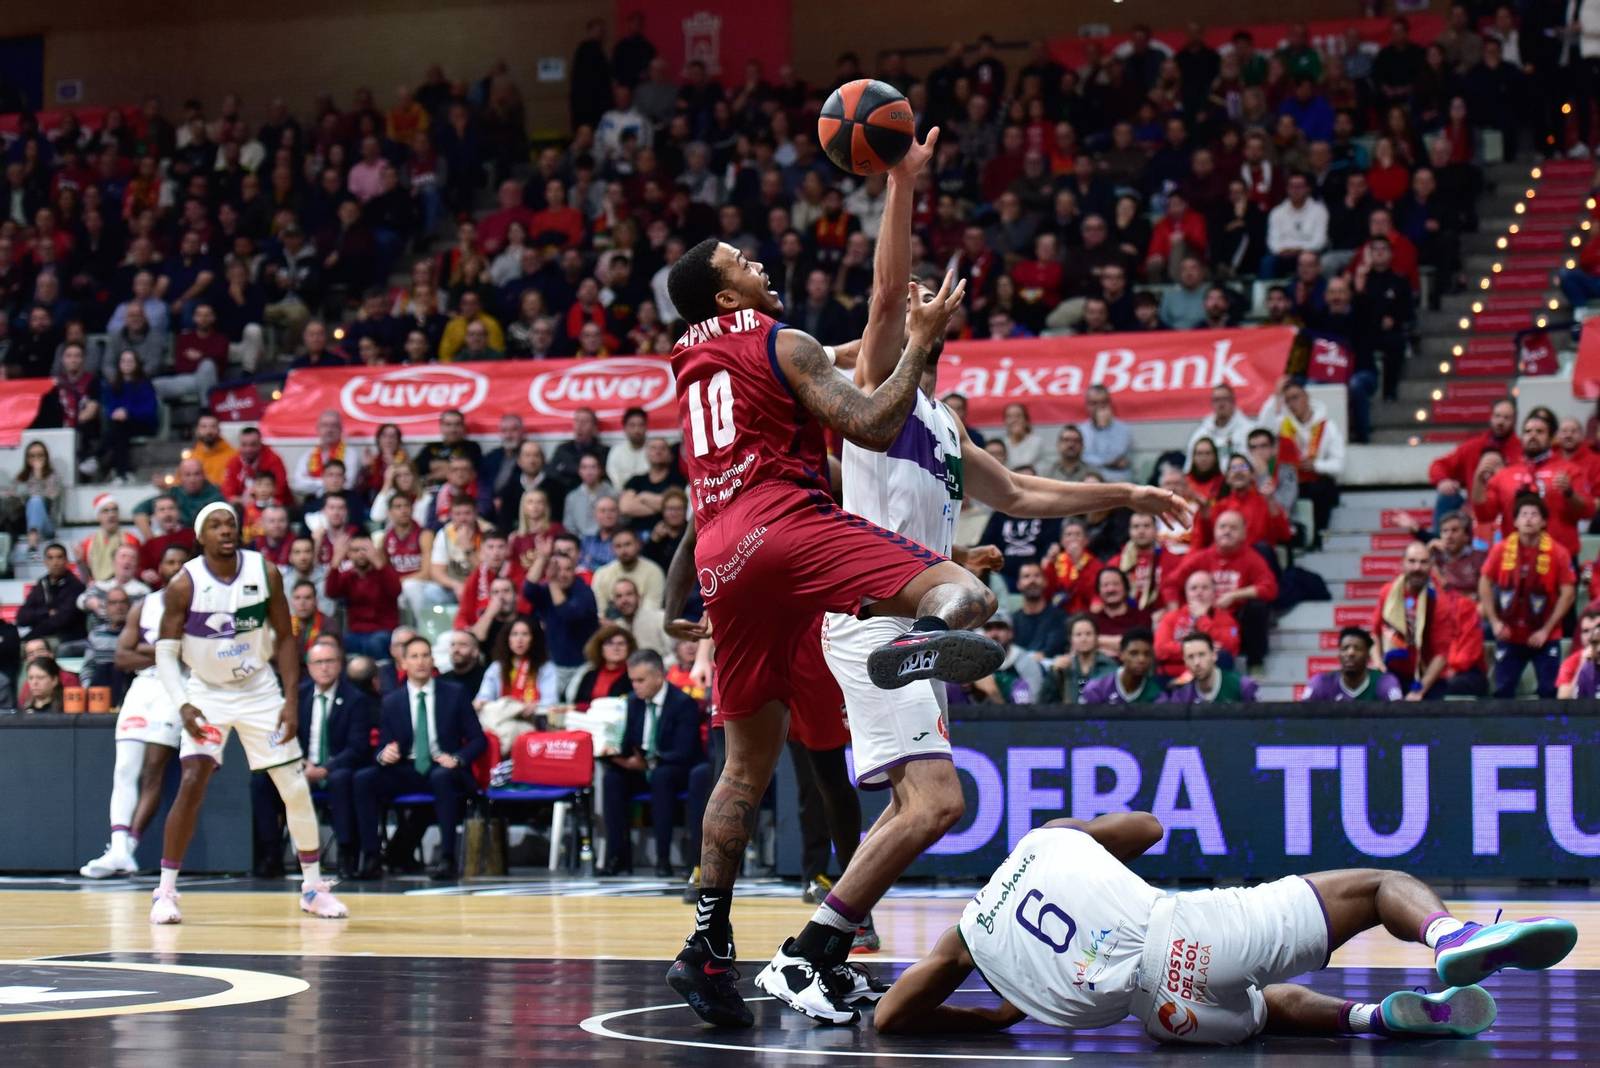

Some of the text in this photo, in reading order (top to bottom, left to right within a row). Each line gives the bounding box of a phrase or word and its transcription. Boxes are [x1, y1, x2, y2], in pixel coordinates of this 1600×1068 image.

[356, 380, 470, 407] Juver
[545, 375, 663, 401] Juver
[688, 369, 736, 458] 10
[705, 492, 717, 504] de
[715, 526, 768, 576] Costa Cálida
[743, 538, 765, 560] Murcia
[1255, 744, 1429, 858] TU
[1015, 888, 1077, 954] 6
[1167, 938, 1186, 993] COSTA
[1181, 941, 1199, 1000] DEL SOL
